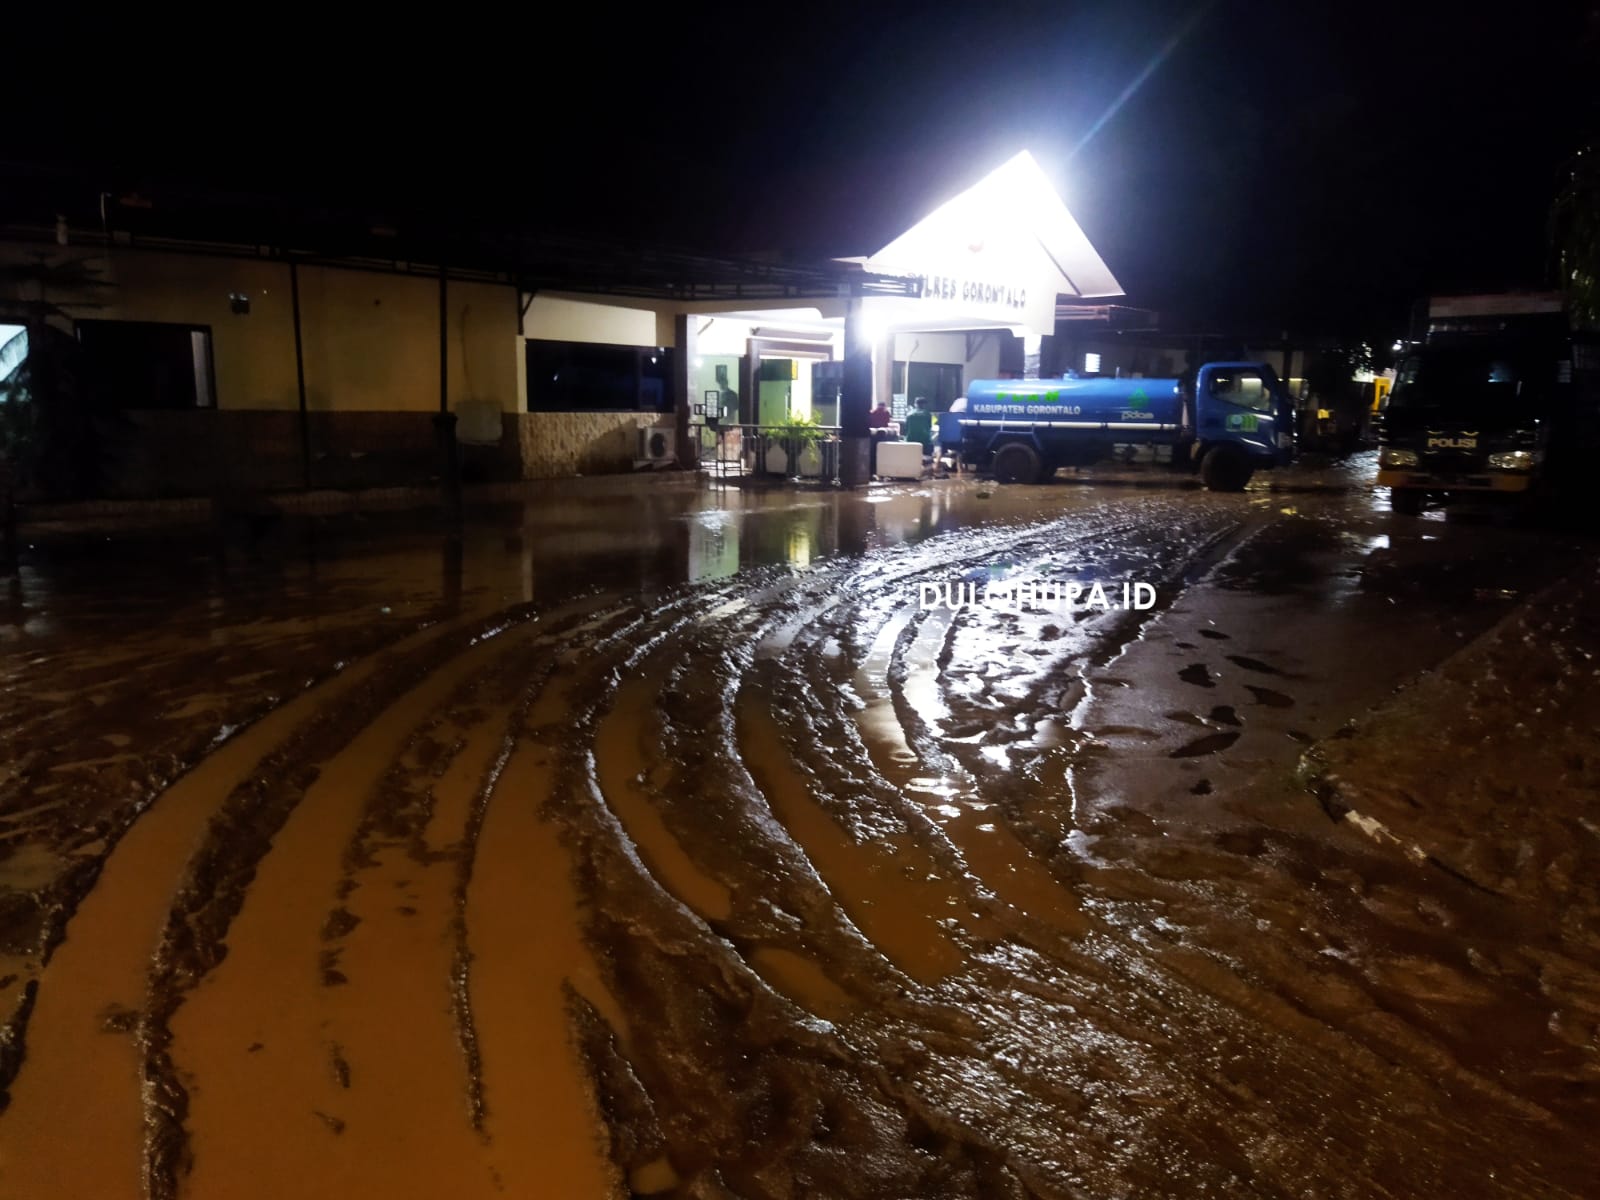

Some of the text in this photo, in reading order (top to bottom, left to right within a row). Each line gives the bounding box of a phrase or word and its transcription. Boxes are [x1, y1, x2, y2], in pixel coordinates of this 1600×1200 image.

[908, 272, 956, 299] LRES
[973, 404, 1081, 414] KABUPATEN GORONTALO
[1428, 438, 1477, 448] POLISI
